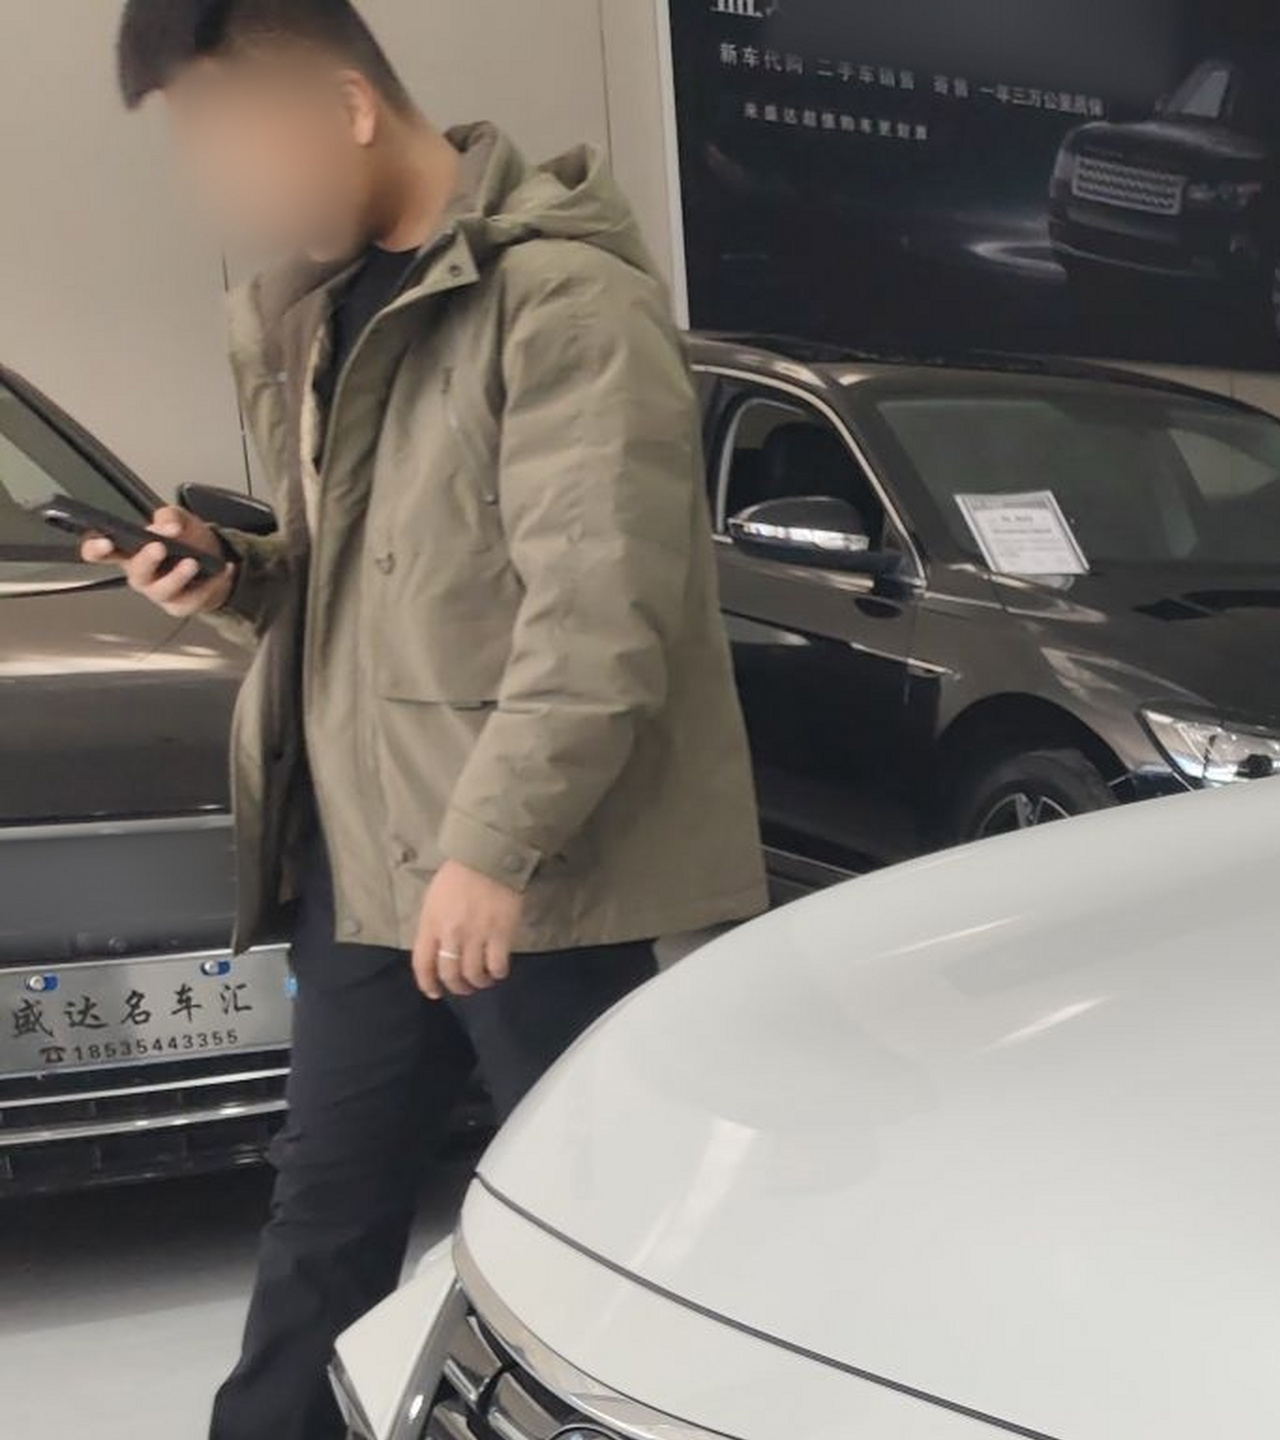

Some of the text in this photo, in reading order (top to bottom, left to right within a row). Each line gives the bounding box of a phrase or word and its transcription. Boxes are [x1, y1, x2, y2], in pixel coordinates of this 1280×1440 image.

[11, 983, 254, 1038] 盛达名车汇
[74, 1028, 239, 1061] 18535443355
